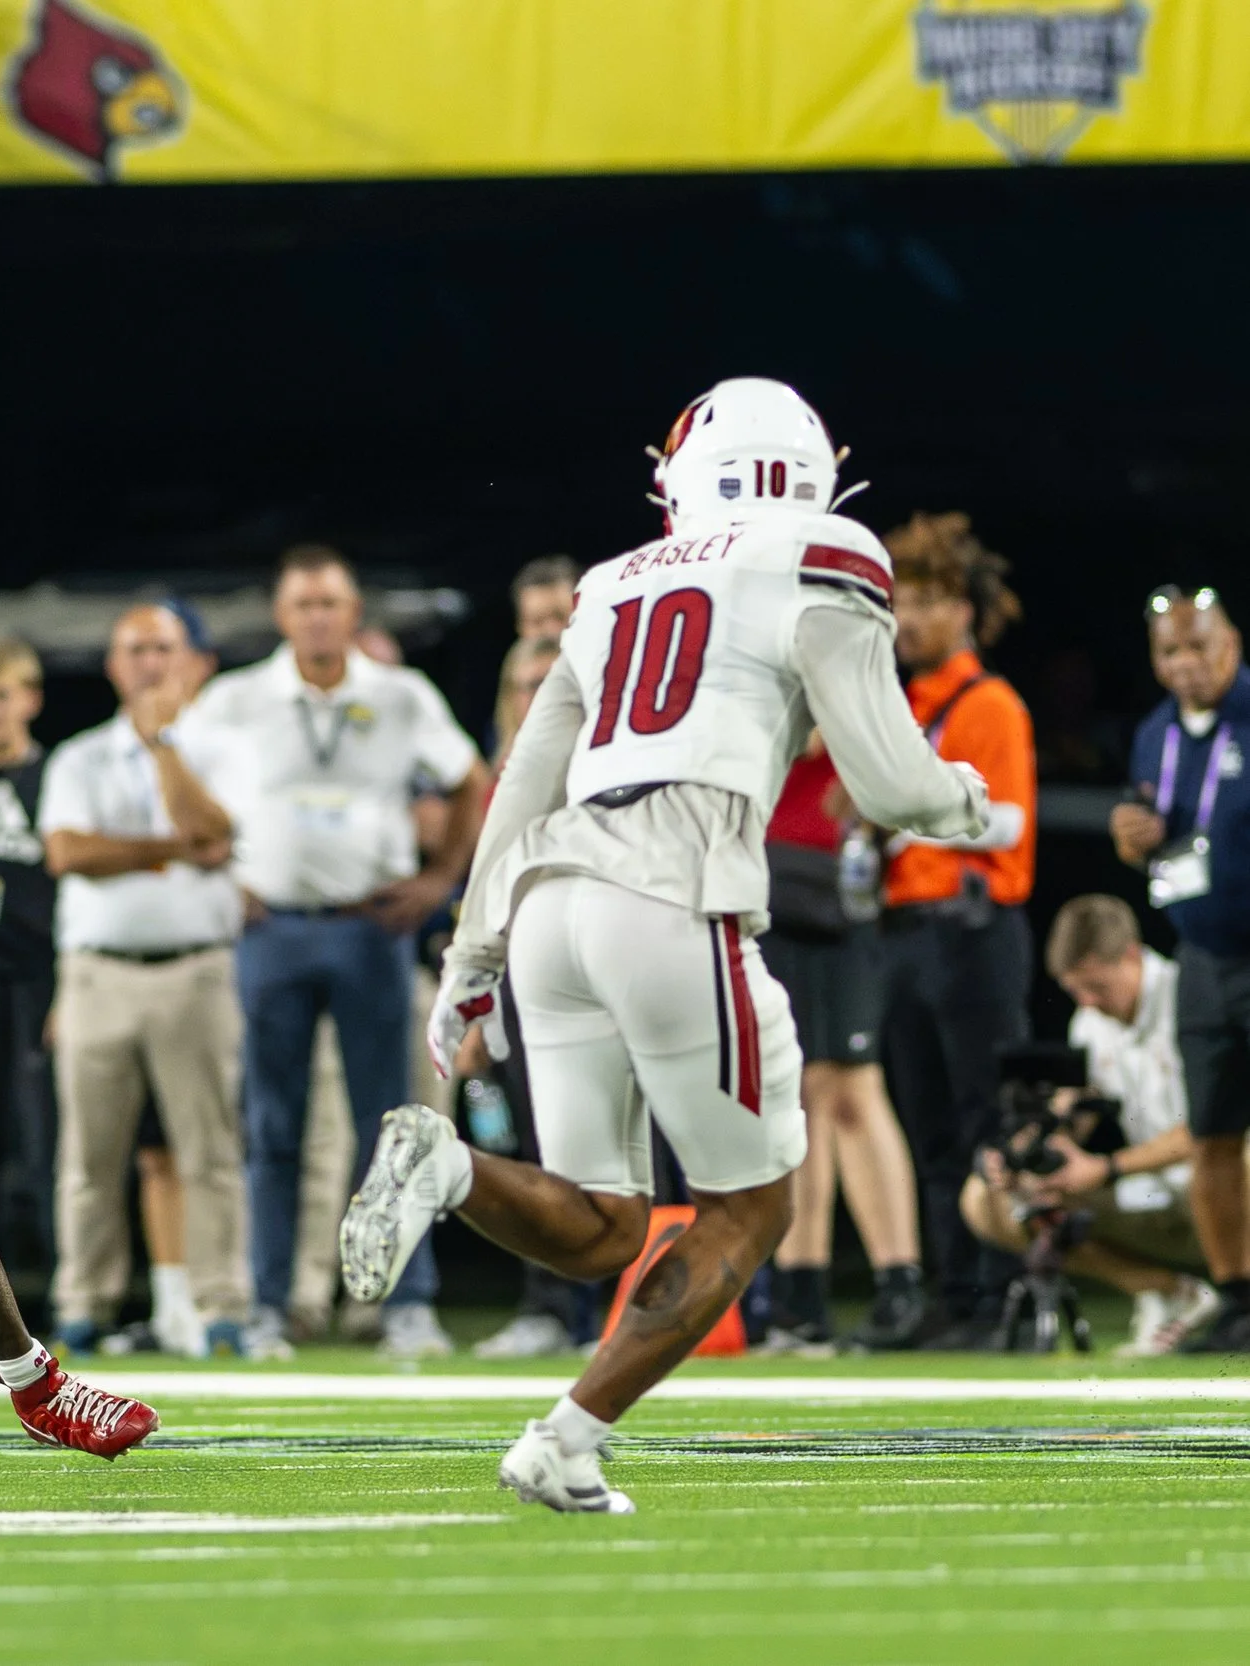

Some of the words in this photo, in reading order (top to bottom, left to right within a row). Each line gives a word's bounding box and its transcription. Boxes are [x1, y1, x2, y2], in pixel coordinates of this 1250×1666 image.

[753, 459, 786, 498] 10
[619, 531, 744, 581] BEASLEY
[589, 586, 713, 751] 10
